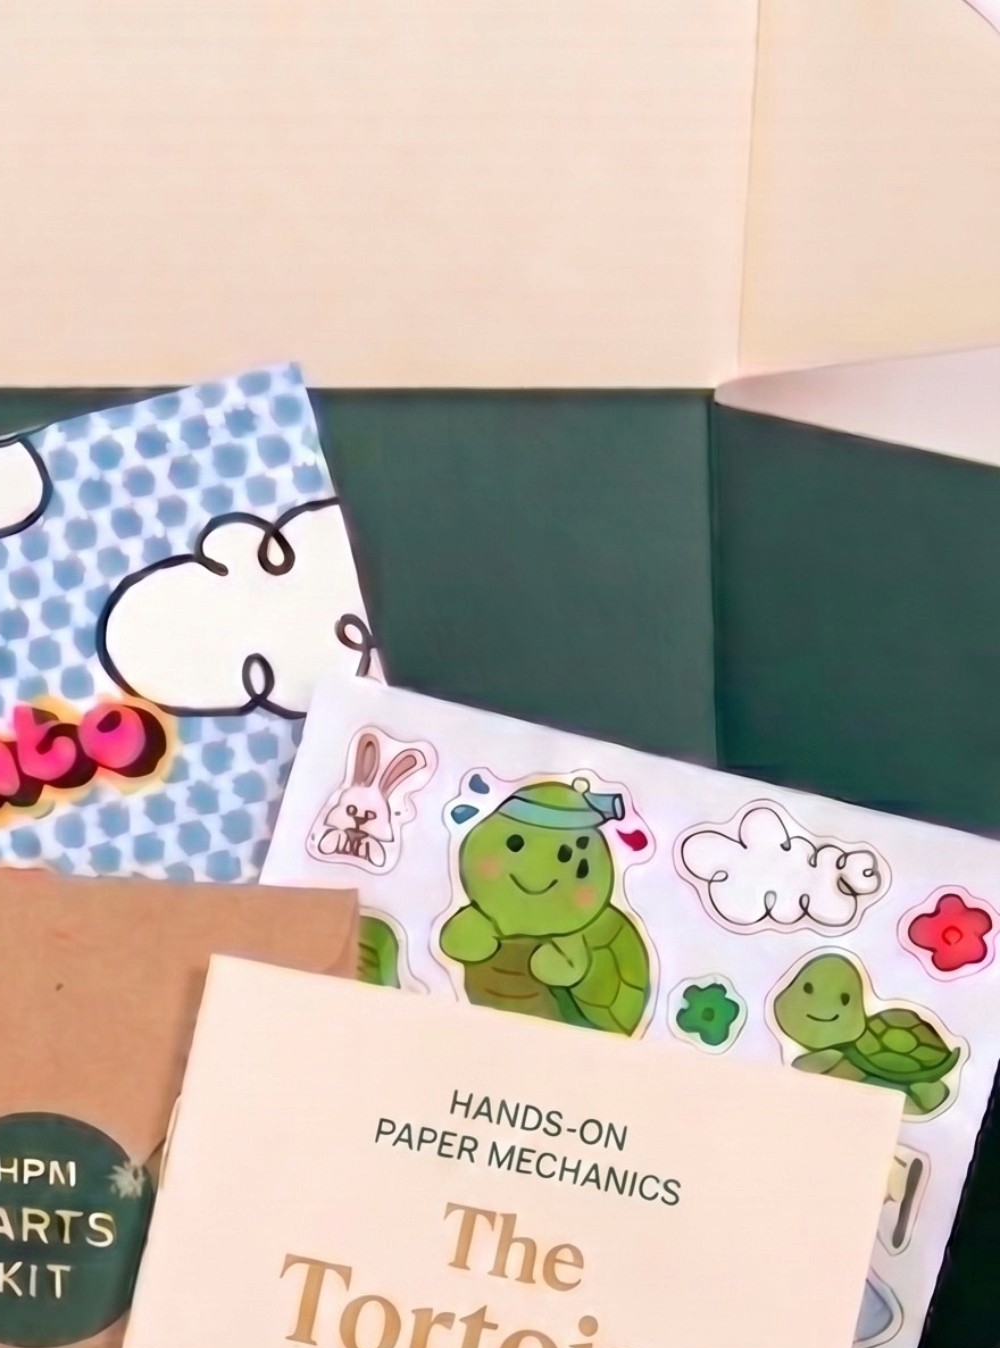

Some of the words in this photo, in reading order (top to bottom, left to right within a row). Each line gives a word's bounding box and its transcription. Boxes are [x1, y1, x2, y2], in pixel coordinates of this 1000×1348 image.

[374, 1118, 479, 1164] PAPER
[487, 1141, 682, 1207] MECHANICS
[449, 1090, 629, 1152] HANDS-ON
[444, 1202, 585, 1292] The
